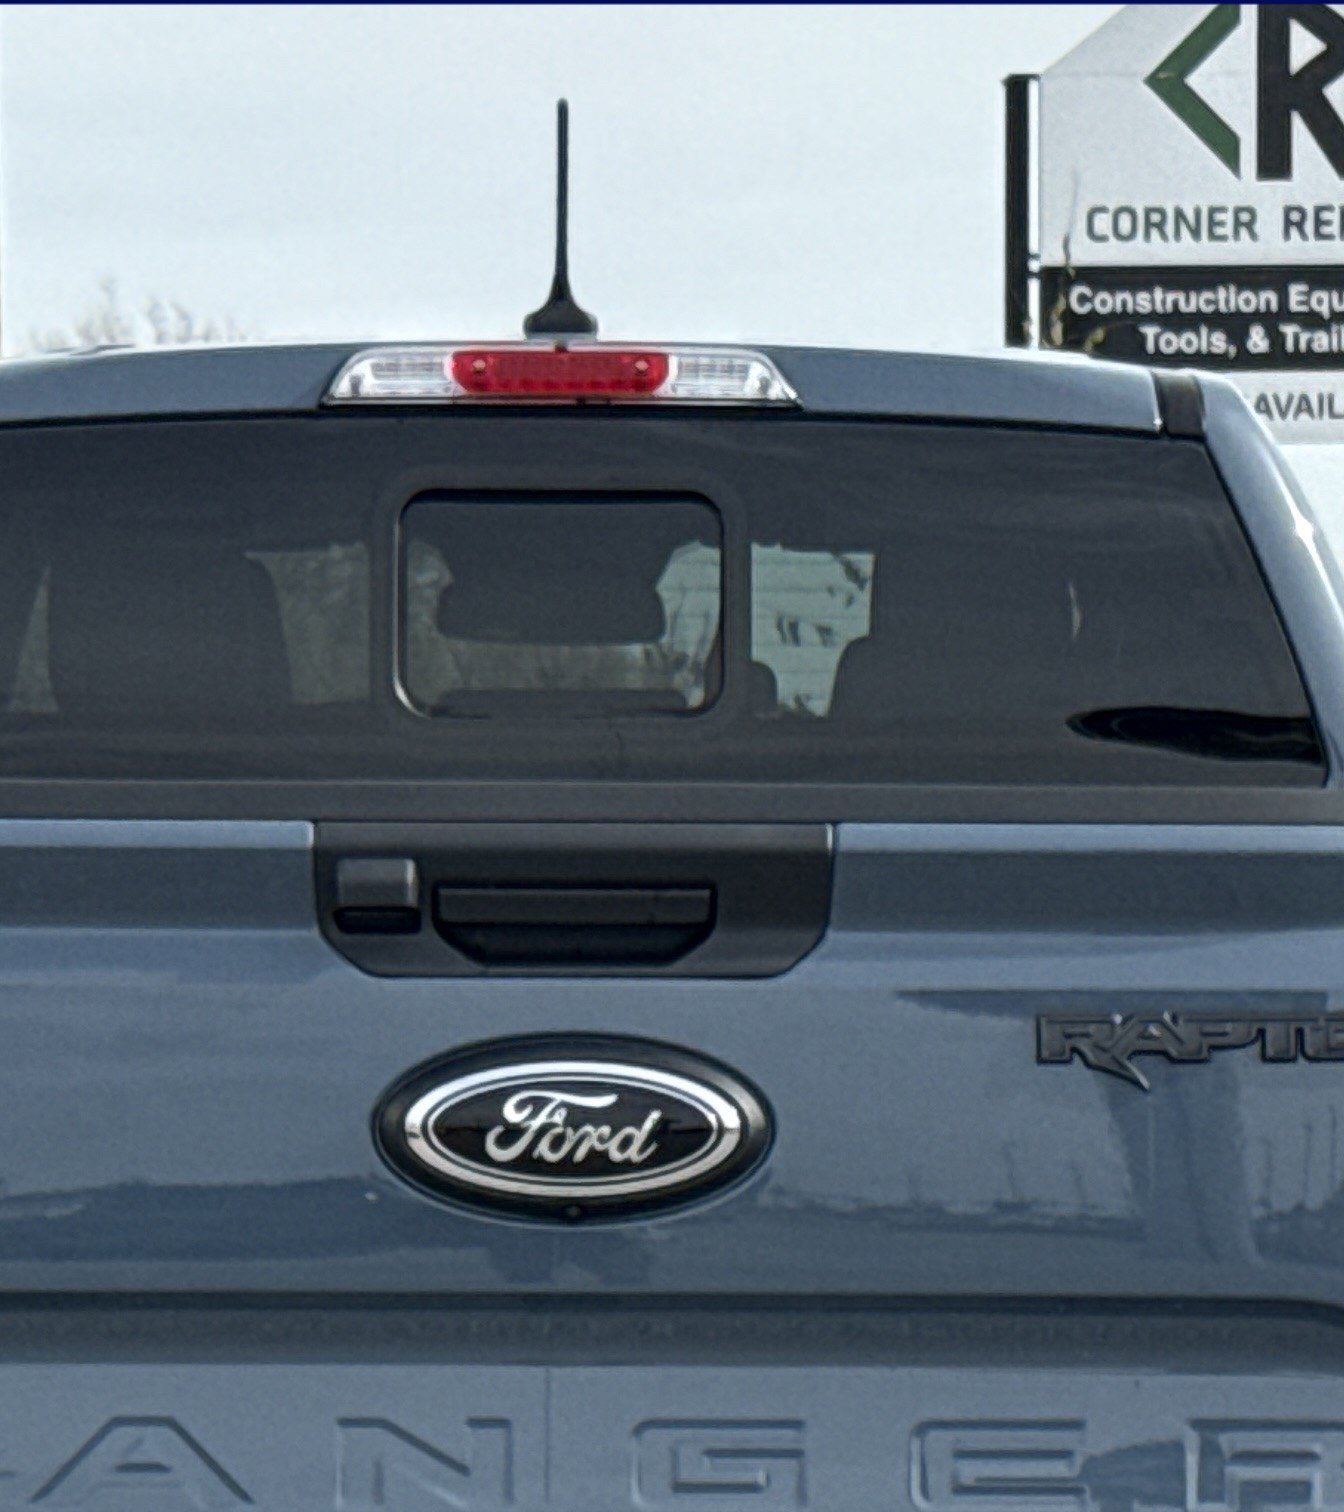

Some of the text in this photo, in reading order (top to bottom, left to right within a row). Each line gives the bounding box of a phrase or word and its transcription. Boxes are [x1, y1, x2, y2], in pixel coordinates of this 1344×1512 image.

[1086, 204, 1258, 243] CORNER
[1069, 284, 1278, 315] Construction
[1139, 324, 1237, 358] Tools,
[1246, 325, 1270, 354] &
[484, 1089, 662, 1163] Ford
